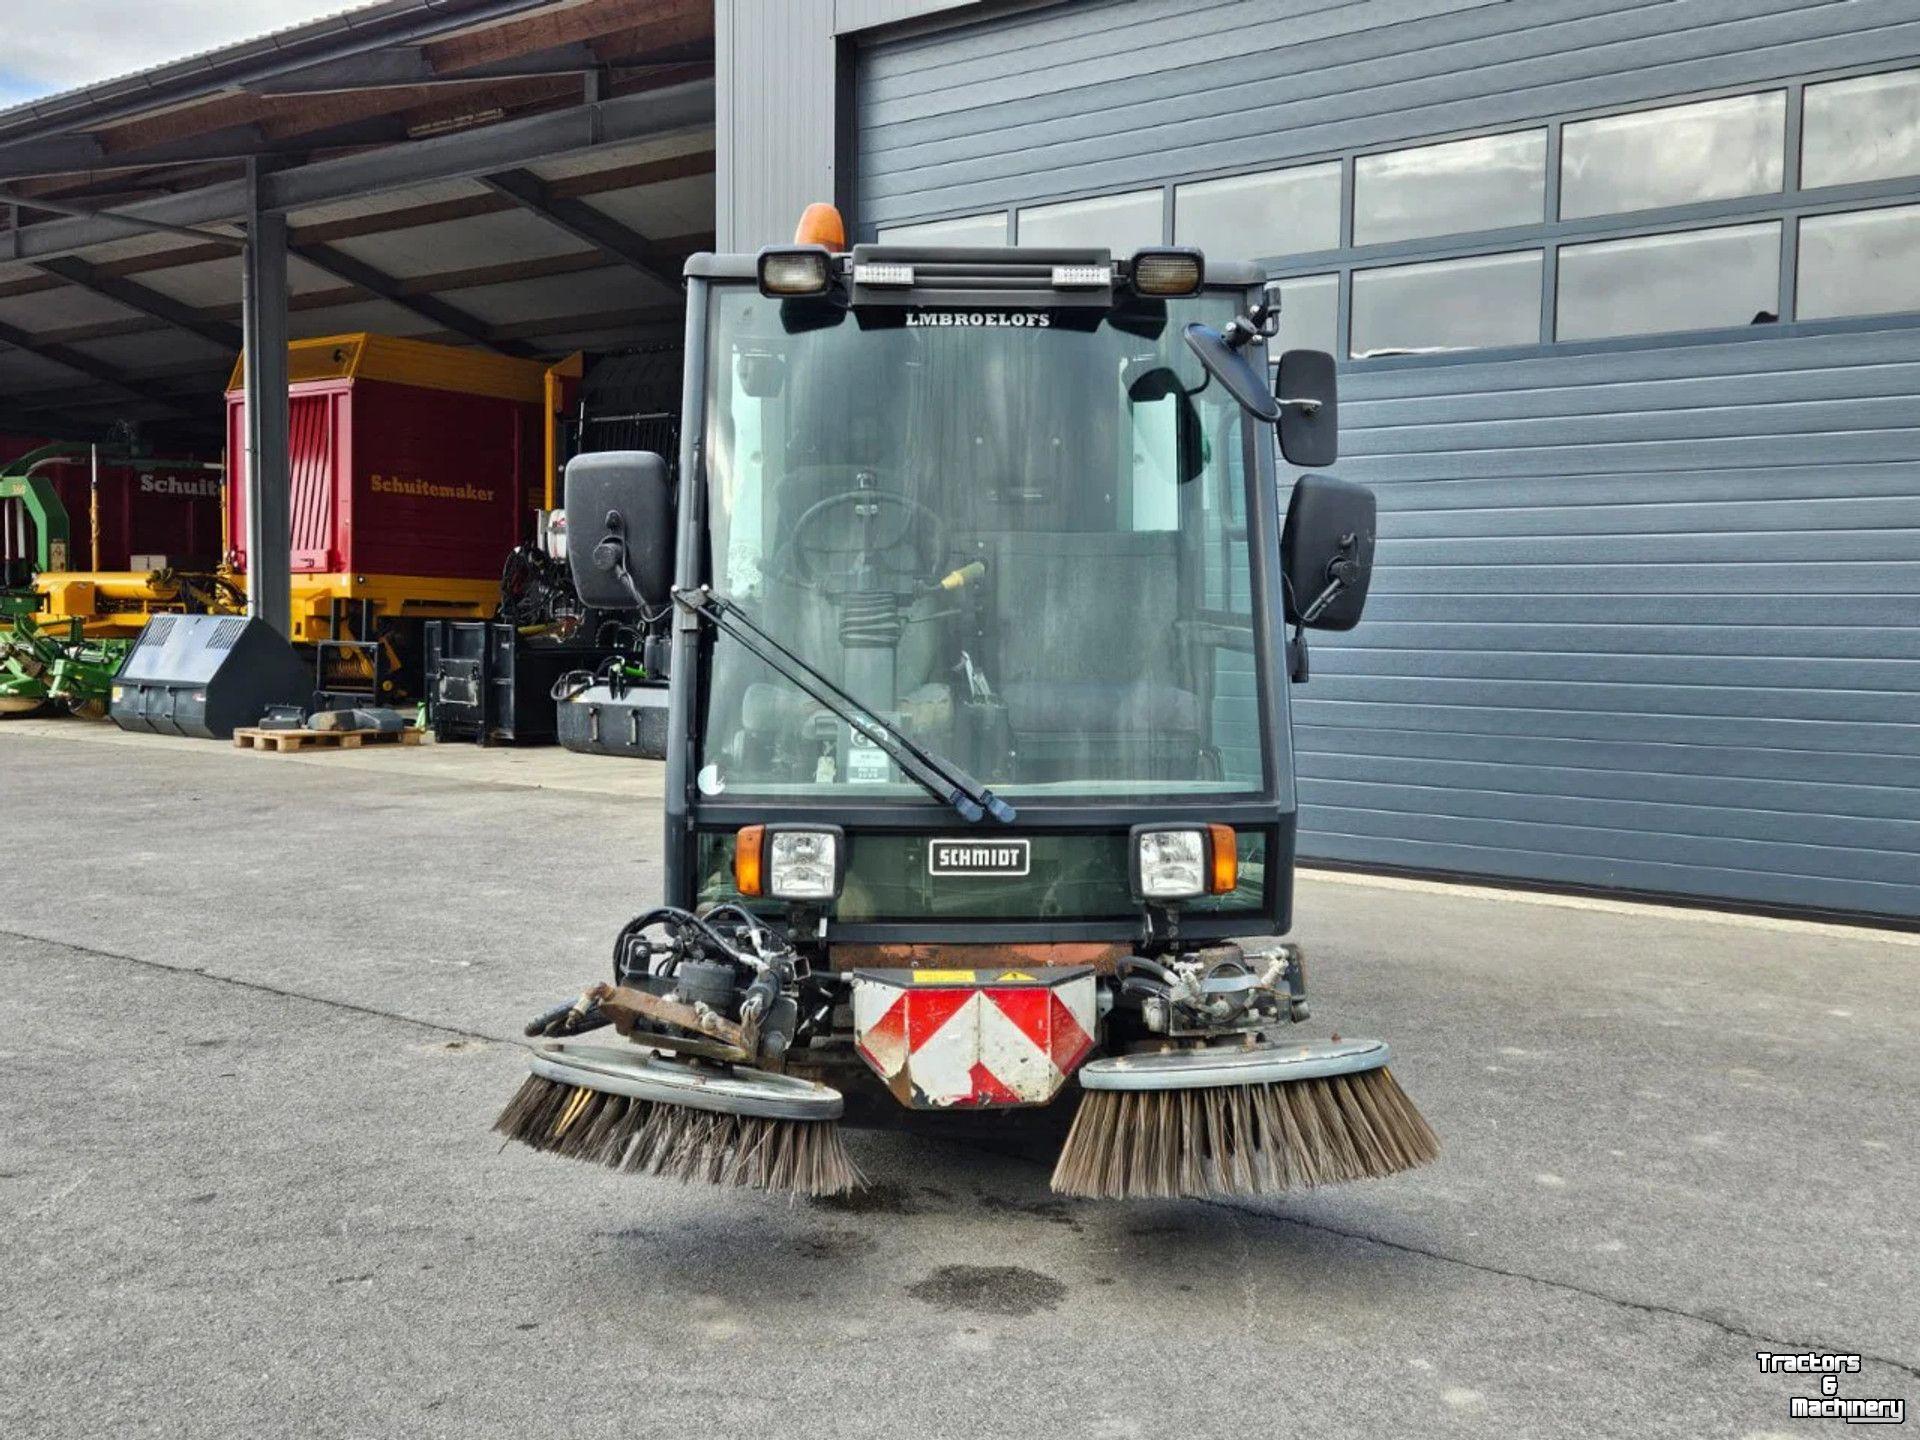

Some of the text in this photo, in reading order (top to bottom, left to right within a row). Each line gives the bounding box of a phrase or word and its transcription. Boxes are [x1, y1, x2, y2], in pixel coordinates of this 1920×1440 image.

[906, 313, 1049, 326] LMBROELOFS
[371, 474, 495, 503] Schuitemaker
[940, 849, 1019, 867] SCHMIDT
